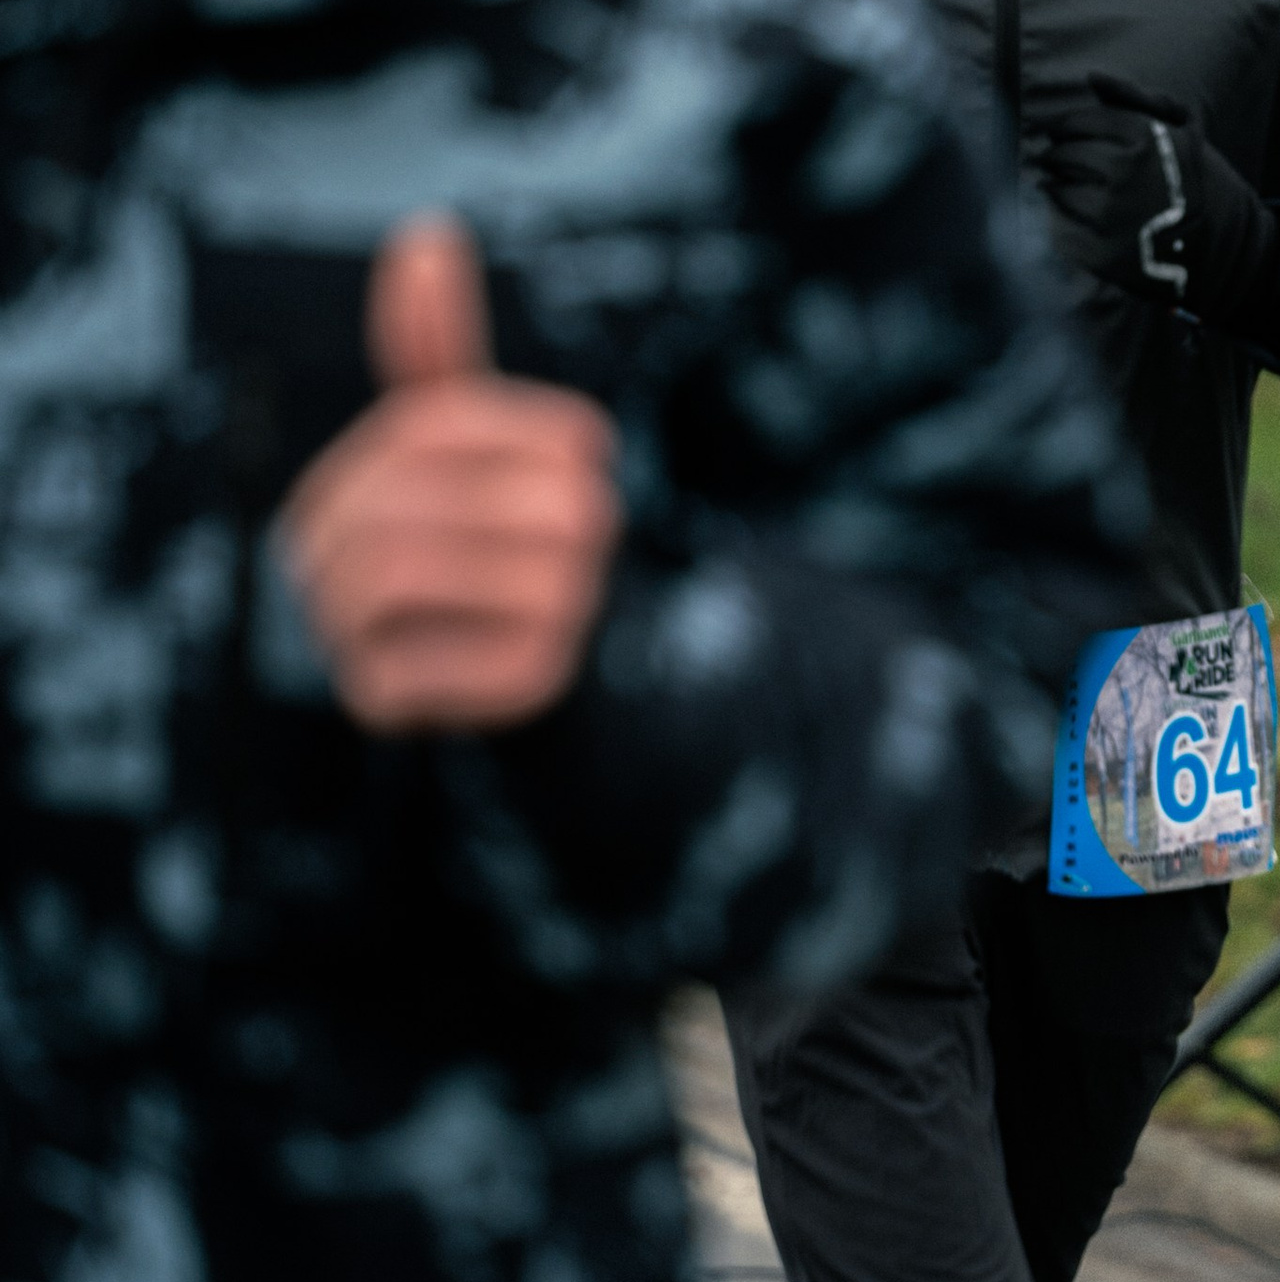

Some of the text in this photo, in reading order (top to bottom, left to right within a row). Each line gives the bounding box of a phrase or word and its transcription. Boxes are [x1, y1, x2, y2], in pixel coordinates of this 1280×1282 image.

[1192, 639, 1234, 665] RUN
[1194, 662, 1235, 689] RIDE
[1068, 665, 1079, 740] RAIL
[1156, 703, 1257, 824] 64
